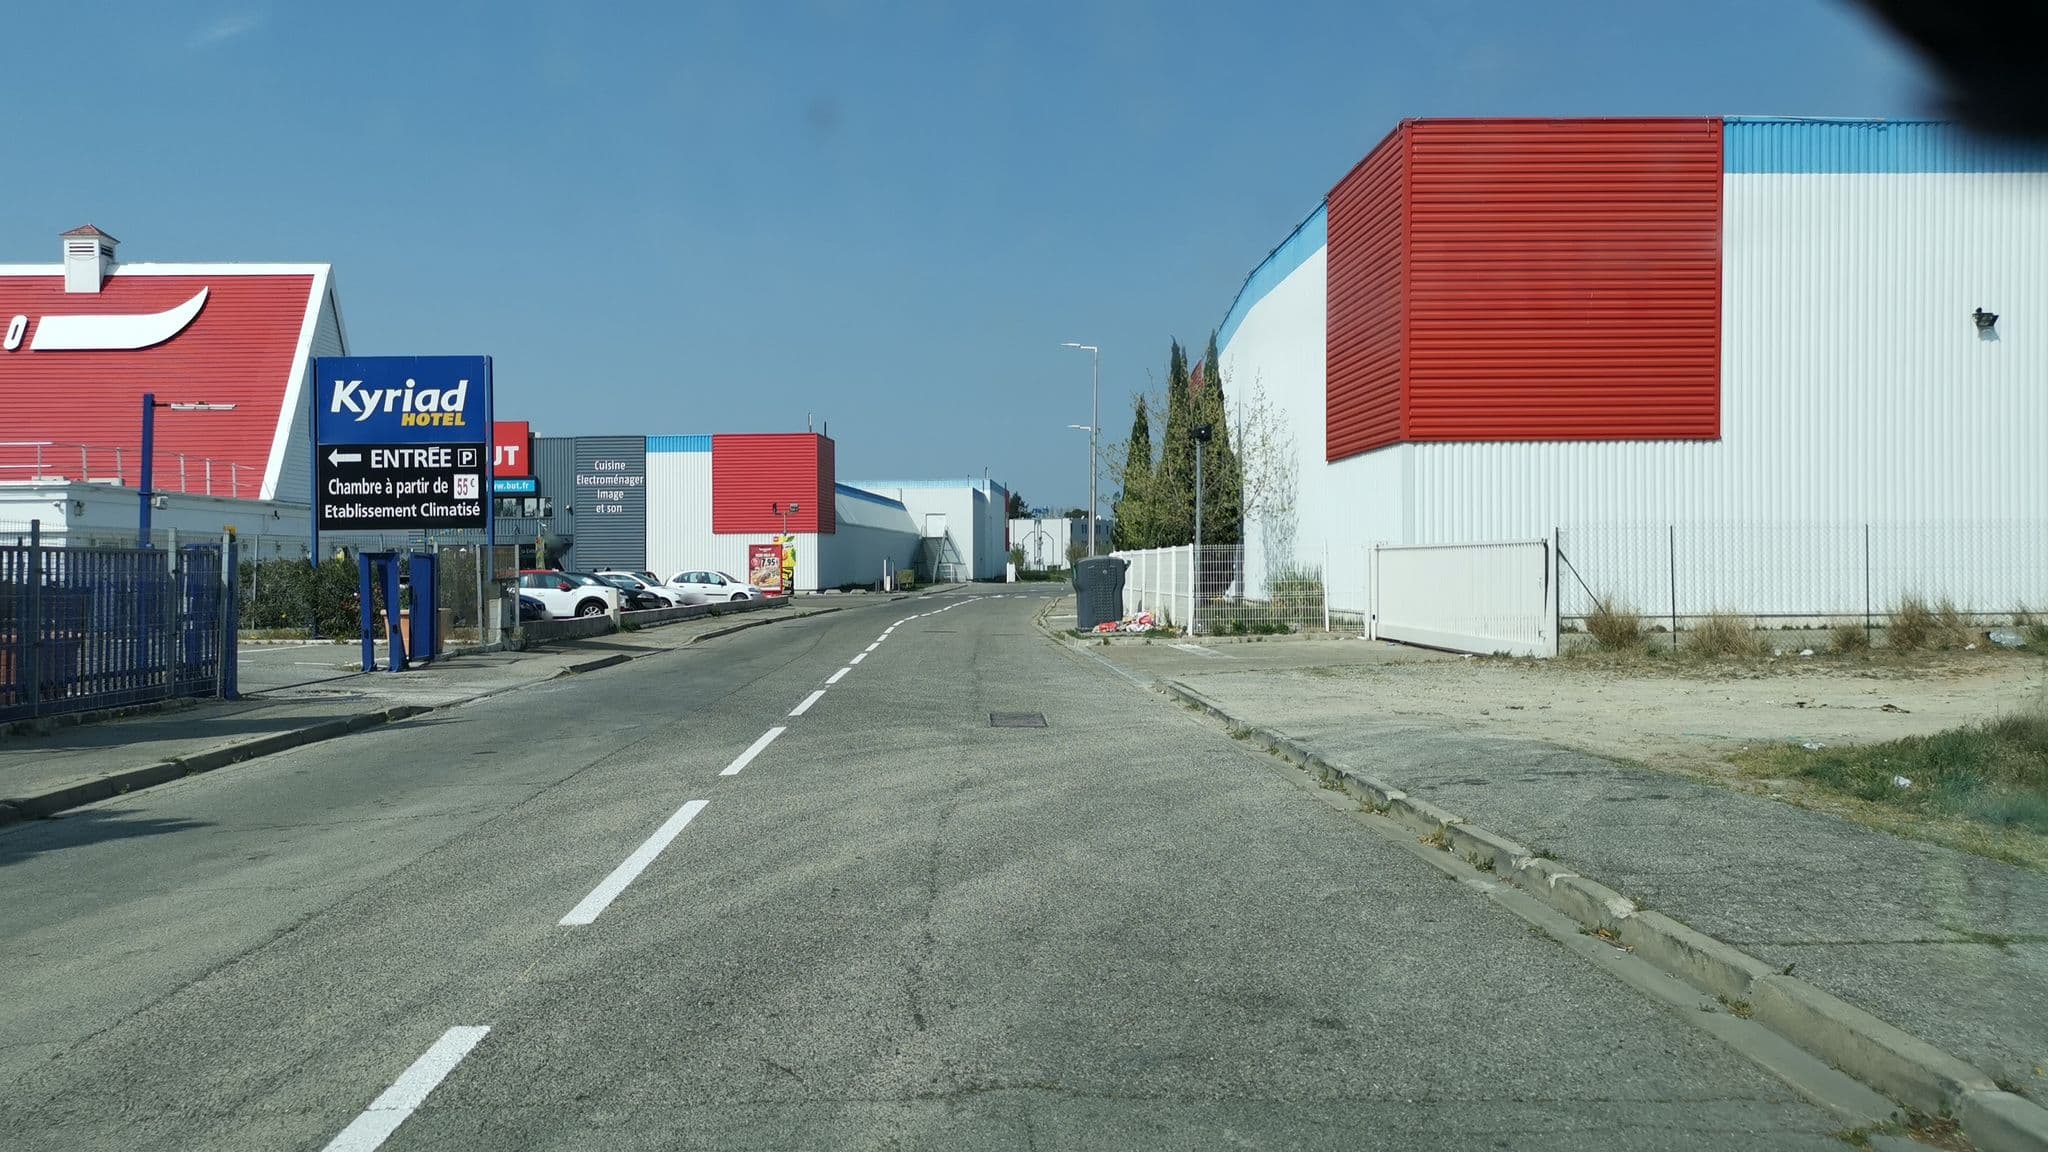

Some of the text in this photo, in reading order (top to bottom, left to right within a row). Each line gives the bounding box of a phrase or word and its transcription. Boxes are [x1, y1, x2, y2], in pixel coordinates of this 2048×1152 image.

[330, 378, 469, 422] Kyriad
[401, 412, 466, 427] HOTEL
[370, 446, 452, 469] ENTRÉE
[594, 460, 626, 471] Cuisine
[328, 477, 382, 496] Chambre
[386, 477, 393, 494] à
[396, 477, 430, 498] partir
[433, 476, 449, 494] de
[576, 474, 644, 486] Electroménager
[597, 489, 624, 501] Image
[325, 502, 481, 519] Etablissement Climatisé
[596, 504, 623, 513] et son
